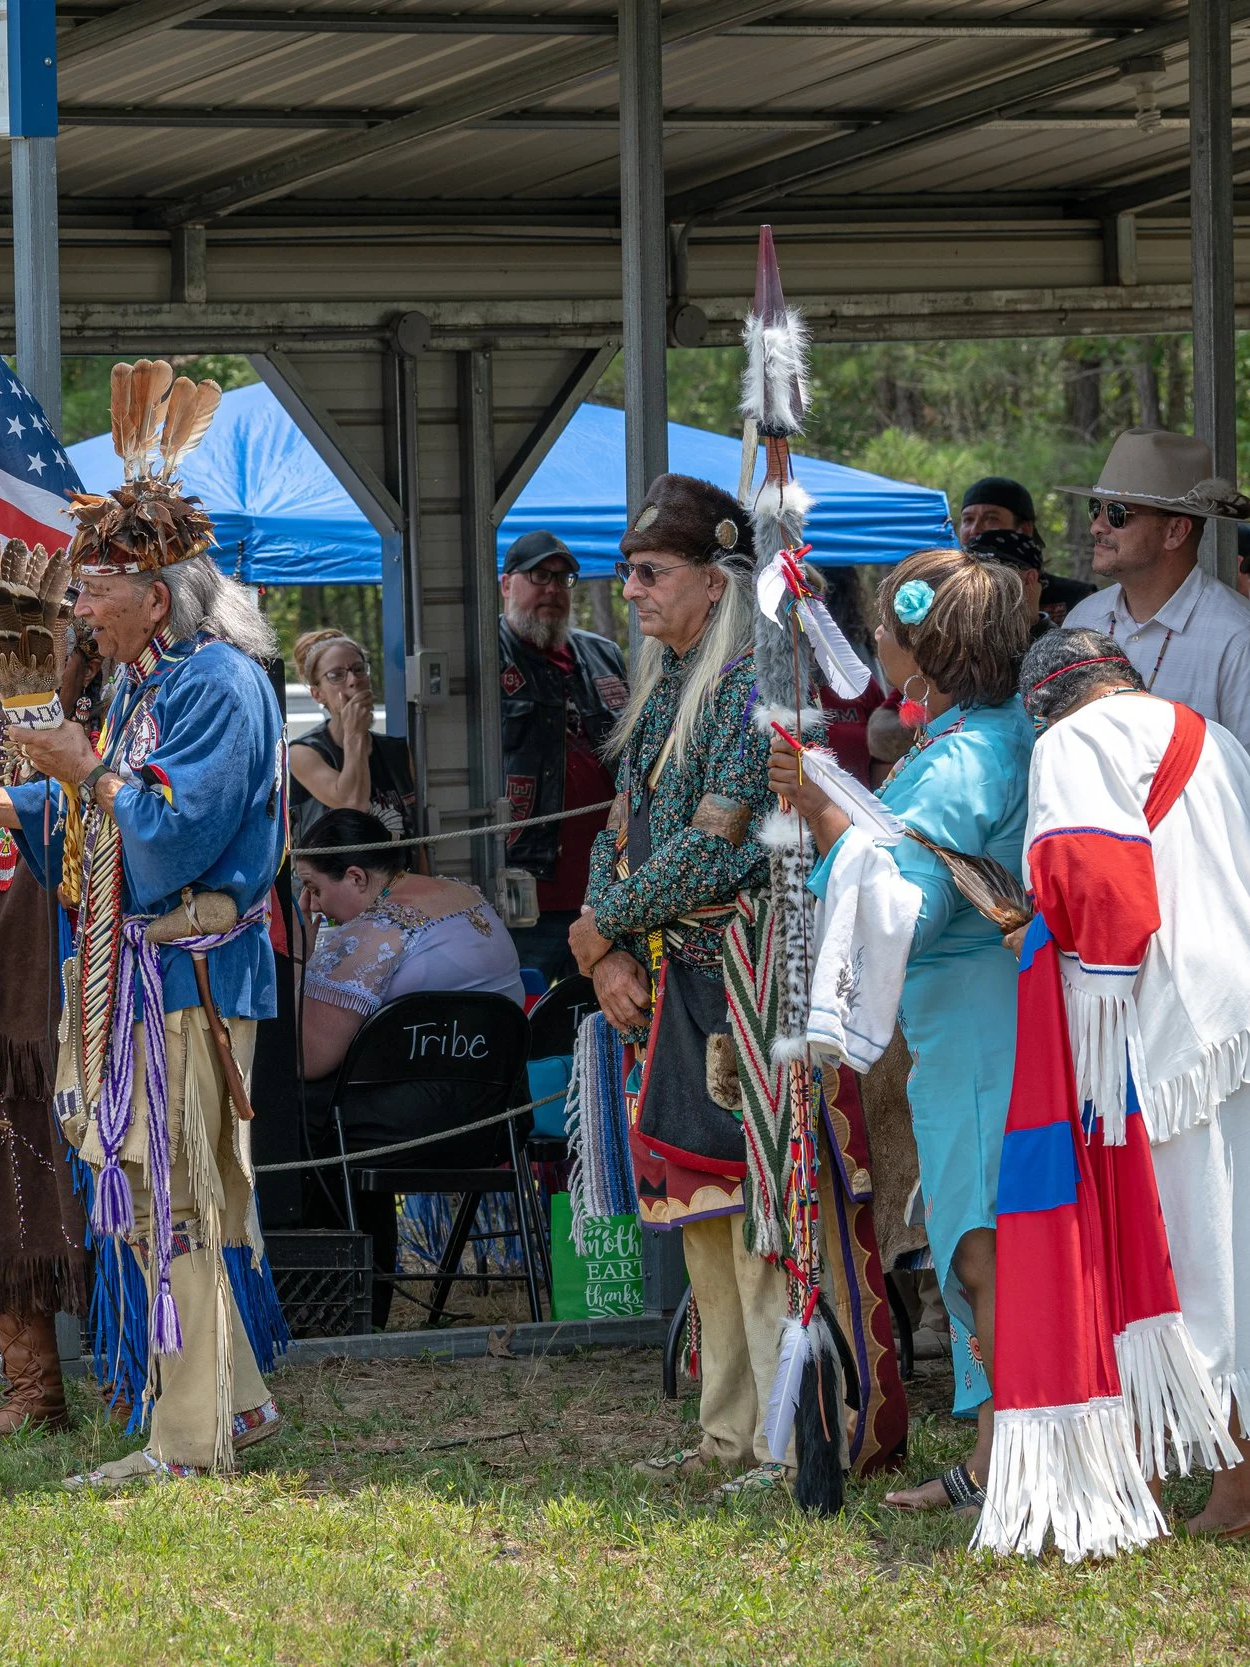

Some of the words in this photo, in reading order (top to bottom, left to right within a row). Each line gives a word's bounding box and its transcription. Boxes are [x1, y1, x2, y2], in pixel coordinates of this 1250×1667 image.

[403, 1020, 488, 1060] Tribe
[585, 1223, 642, 1259] moth
[586, 1261, 642, 1280] EART
